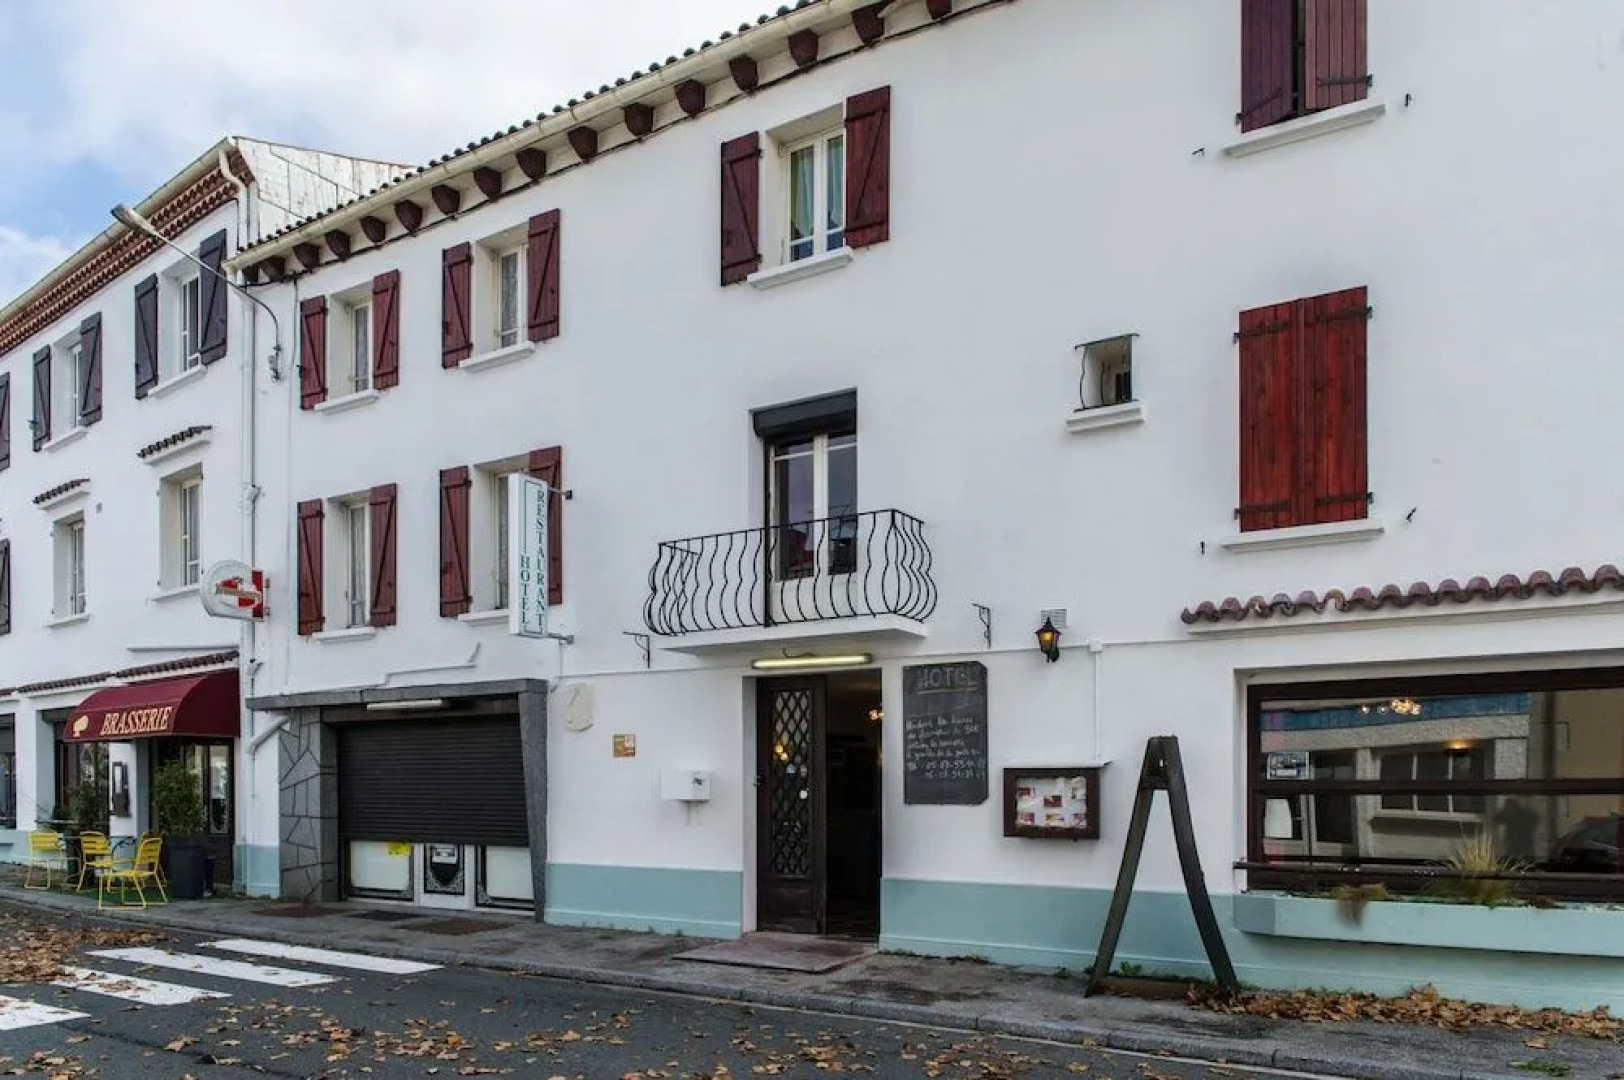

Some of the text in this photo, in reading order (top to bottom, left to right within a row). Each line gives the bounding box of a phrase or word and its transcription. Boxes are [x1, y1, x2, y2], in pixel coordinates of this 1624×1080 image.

[520, 554, 530, 624] HOTEL
[536, 489, 545, 626] RESTAURANT
[100, 706, 173, 735] BRASSERIE
